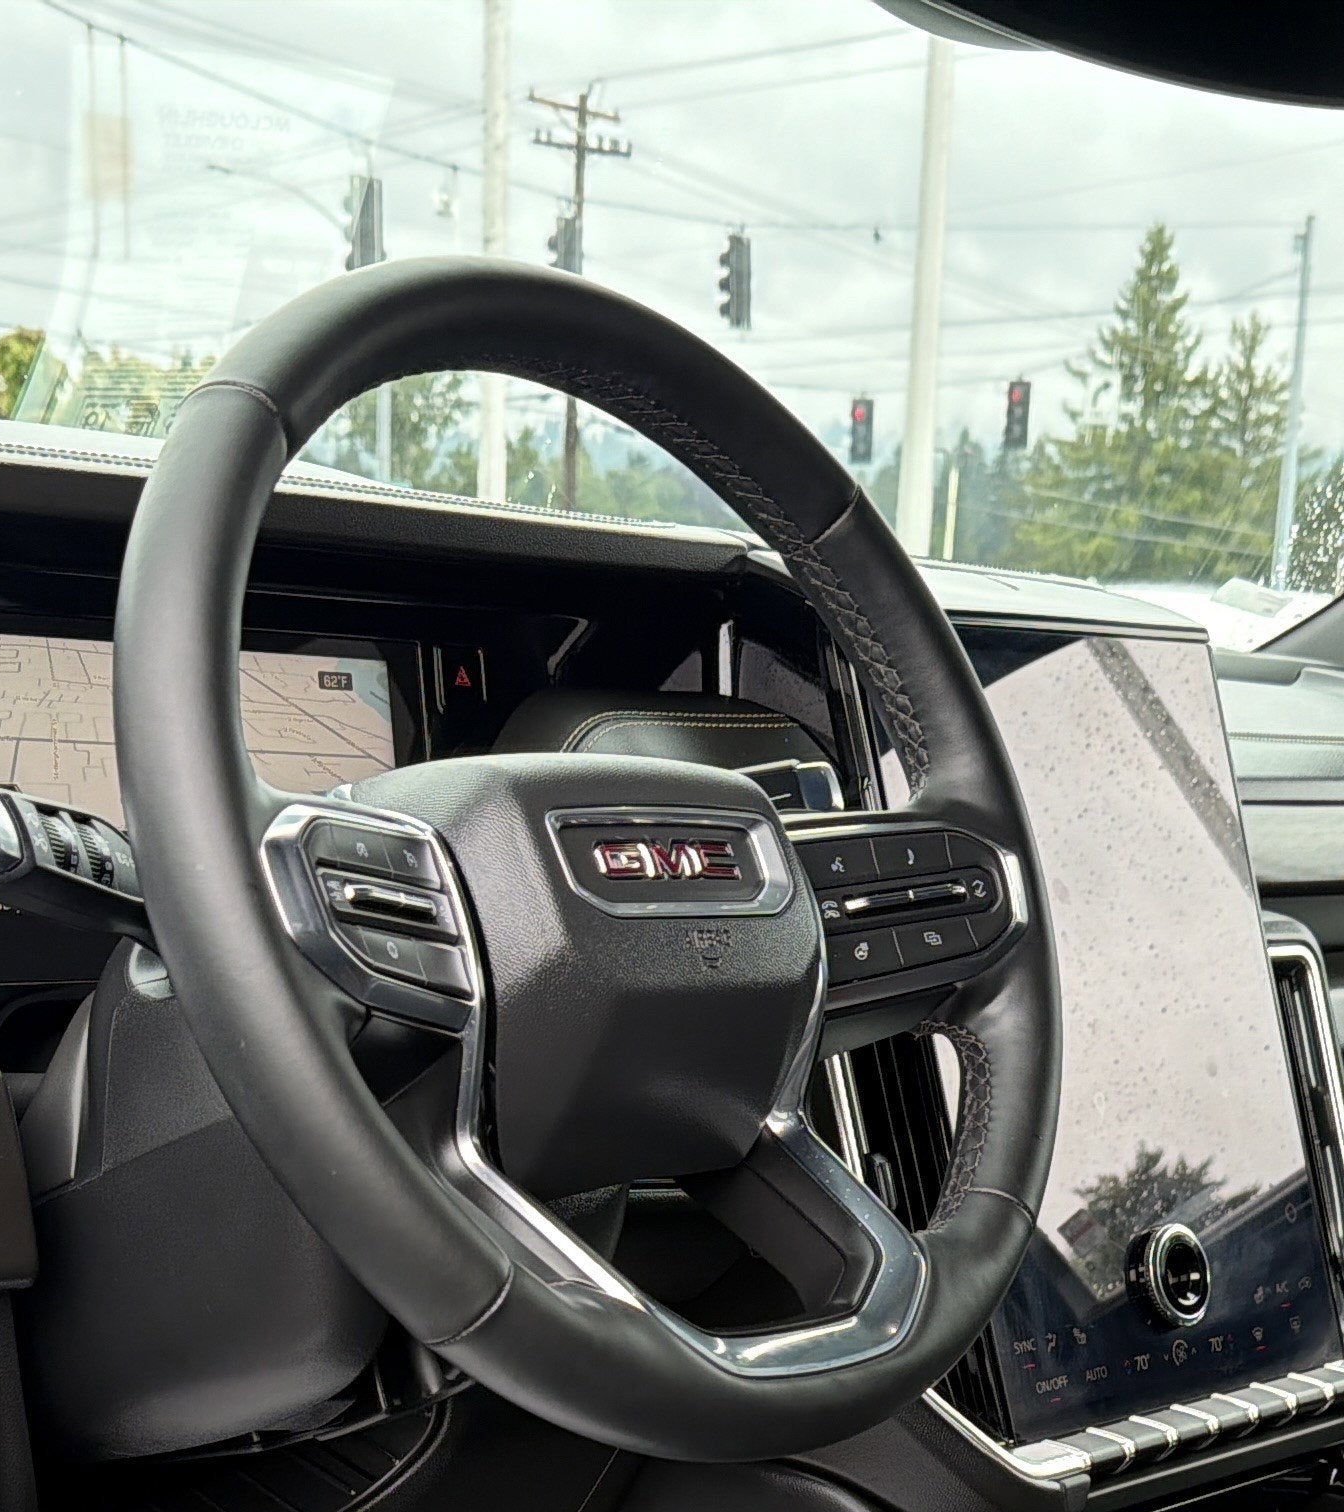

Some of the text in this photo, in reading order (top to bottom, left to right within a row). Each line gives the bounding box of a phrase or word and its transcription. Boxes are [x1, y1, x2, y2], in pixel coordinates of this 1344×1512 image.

[593, 838, 742, 881] GMC
[1014, 1338, 1037, 1355] SYNC
[1085, 1366, 1108, 1382] AUTO
[1036, 1375, 1069, 1394] ON/OFF
